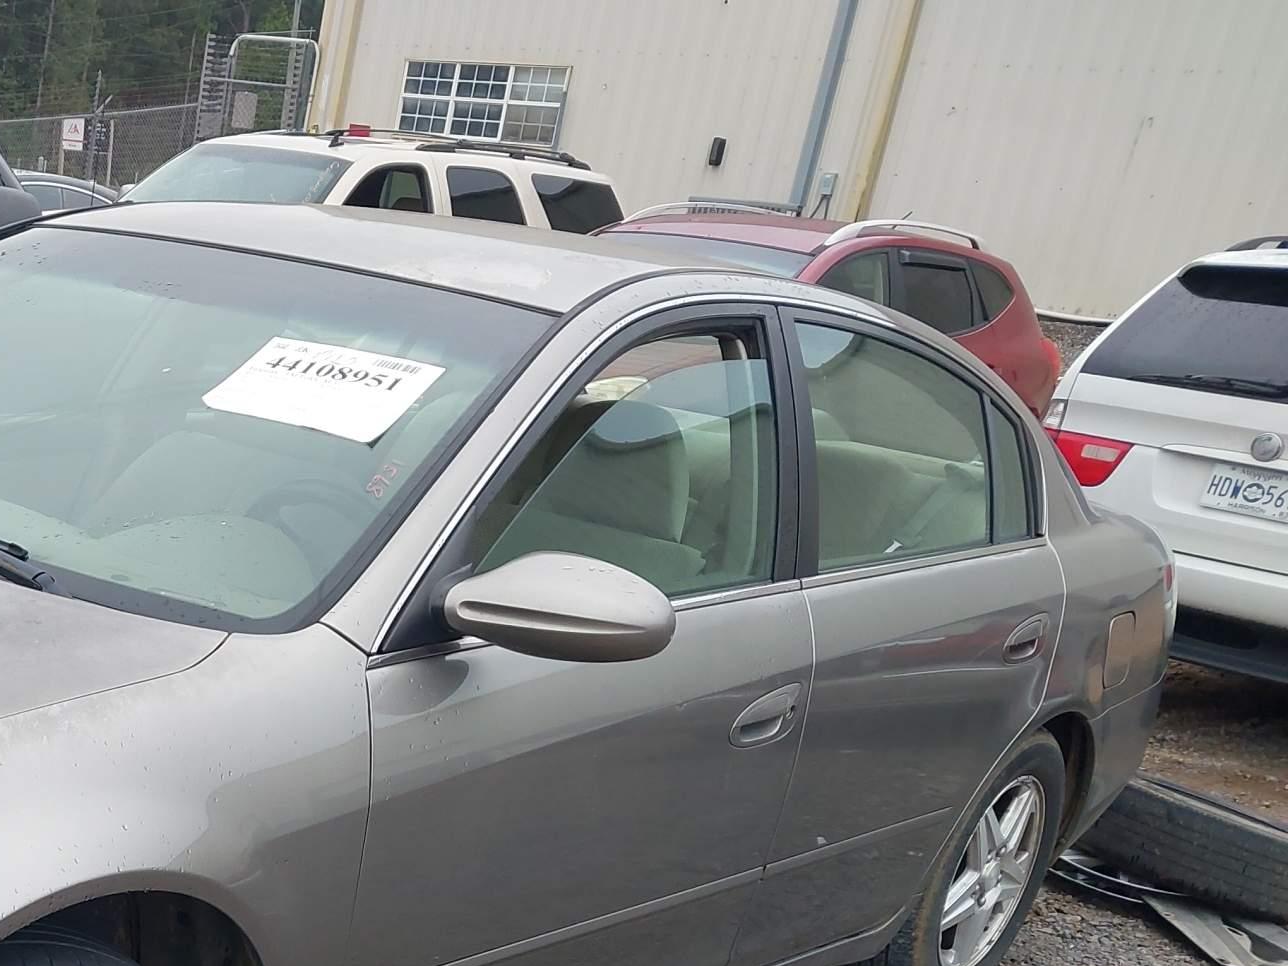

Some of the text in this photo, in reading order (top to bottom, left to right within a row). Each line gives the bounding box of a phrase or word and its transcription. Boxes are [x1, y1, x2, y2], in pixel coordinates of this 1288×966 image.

[265, 355, 403, 391] 44108951
[1206, 474, 1288, 509] HDW 56
